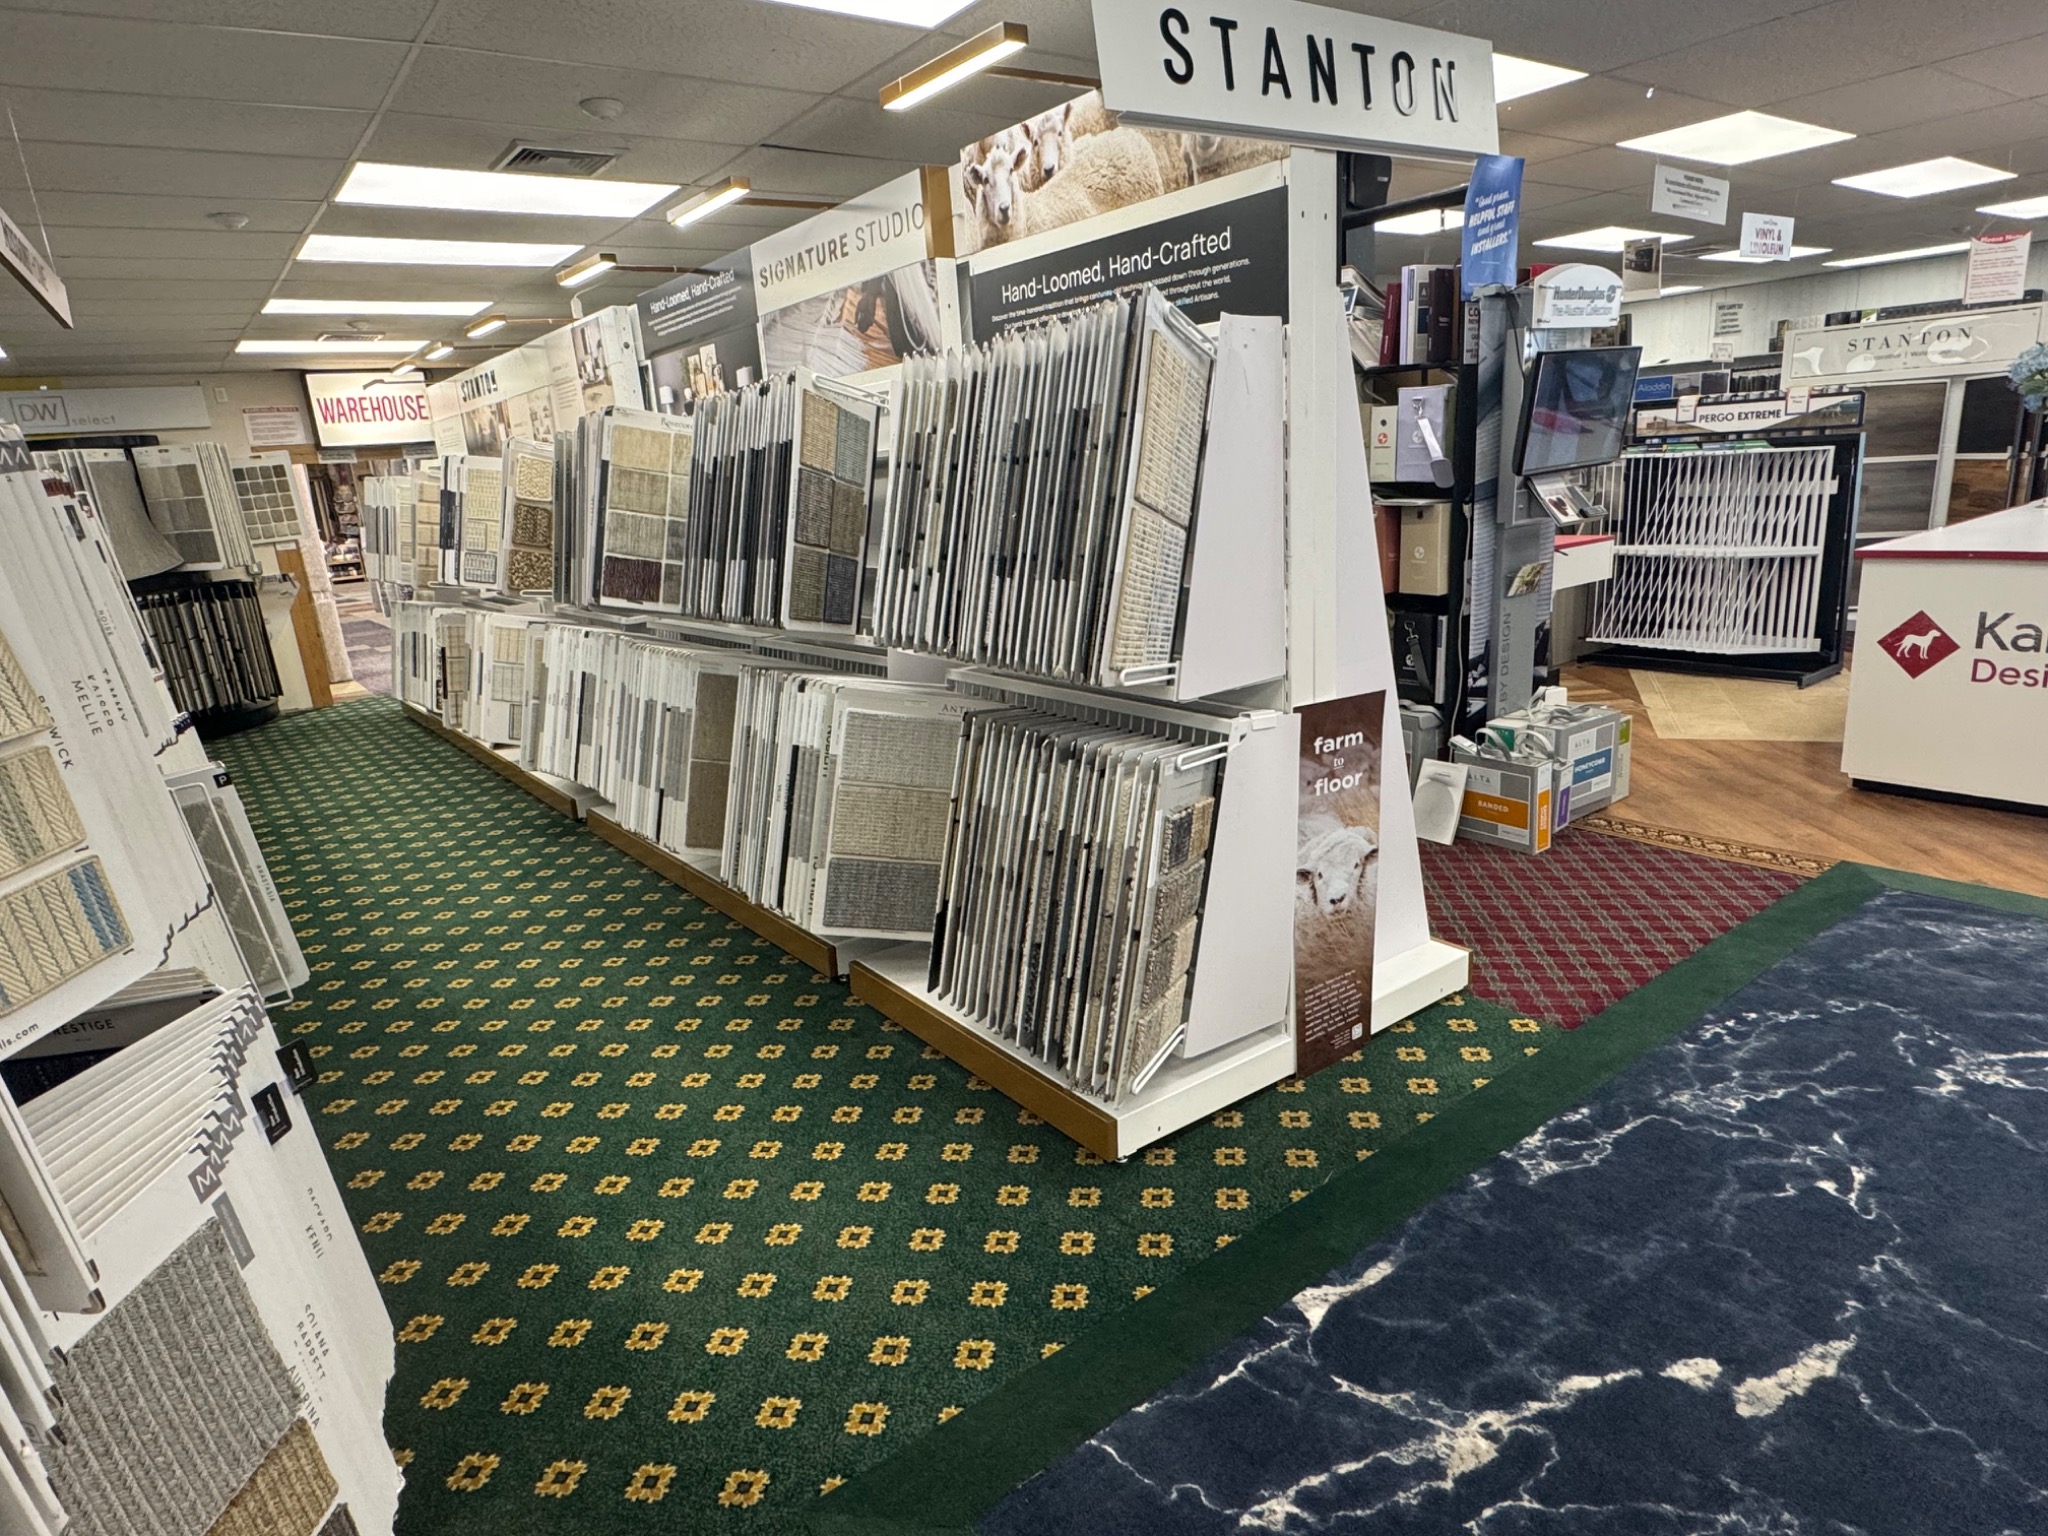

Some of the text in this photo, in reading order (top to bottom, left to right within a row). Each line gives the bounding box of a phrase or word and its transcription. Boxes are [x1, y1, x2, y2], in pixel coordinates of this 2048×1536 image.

[1158, 7, 1460, 123] STANTON
[759, 202, 925, 289] SIGNATURE STUDIO
[1755, 227, 1782, 242] VINYL &
[1750, 241, 1784, 256] LINOLEUM
[1001, 225, 1232, 306] Hand-Loomed, Hand-Crafted
[690, 266, 735, 299] Hand-Crafted
[1847, 326, 1974, 354] STANTON
[1636, 382, 1672, 393] Aladdin
[18, 402, 117, 427] DW select
[315, 394, 430, 425] WAREHOUSE
[1699, 409, 1782, 424] PERGO EXTREME
[1500, 612, 1512, 676] DESIGN
[1975, 611, 2048, 654] Ka
[1498, 680, 1509, 703] BY
[71, 680, 104, 736] MELLIE
[1313, 730, 1364, 755] farm
[1333, 756, 1345, 769] to
[218, 775, 227, 785] P
[1313, 771, 1364, 797] floor
[1477, 799, 1510, 813] BANDED
